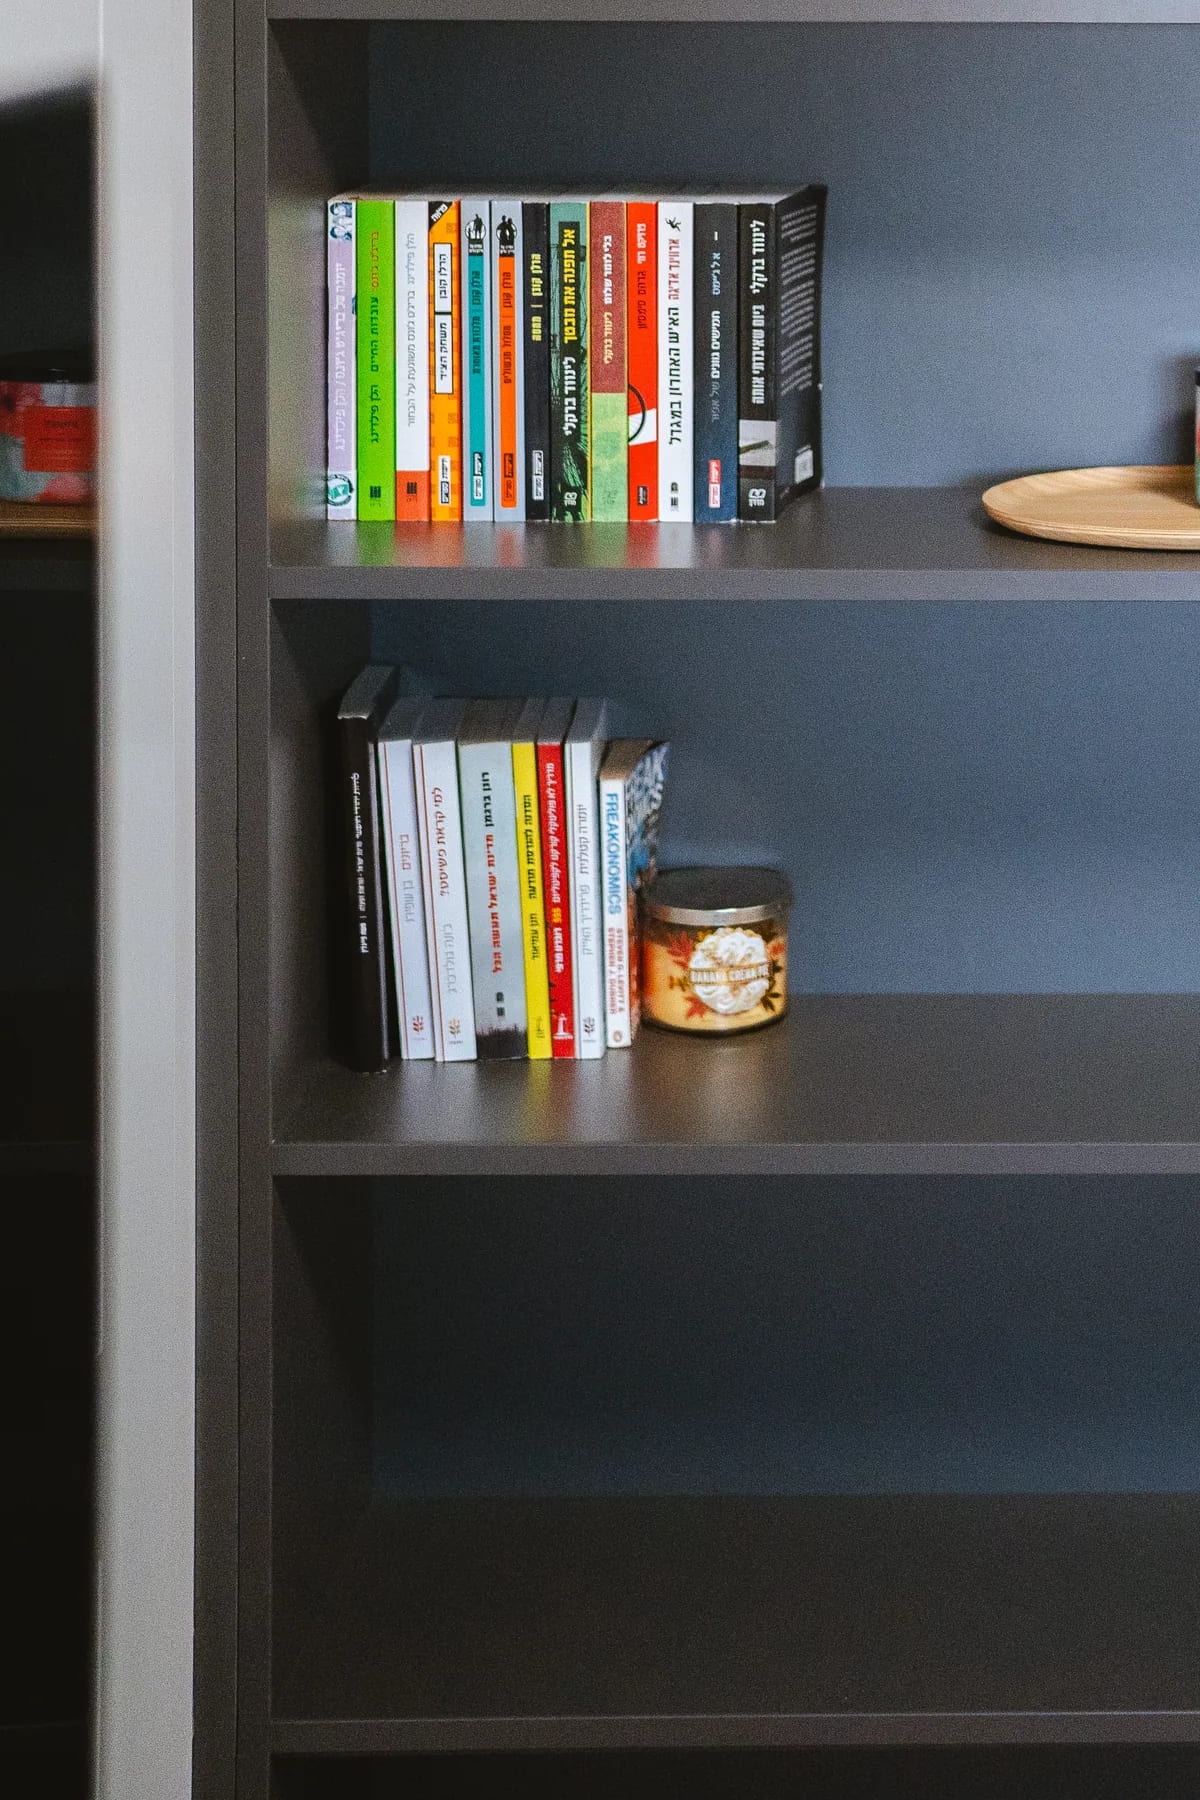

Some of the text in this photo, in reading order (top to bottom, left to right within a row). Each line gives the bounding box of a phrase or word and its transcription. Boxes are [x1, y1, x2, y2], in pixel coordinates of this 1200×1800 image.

[405, 233, 416, 249] הלן
[562, 228, 574, 246] אל
[437, 253, 448, 298] הרלן קובן
[563, 250, 574, 283] תפנה
[750, 258, 767, 293] ברקלי
[563, 286, 575, 303] את
[603, 280, 612, 304] שלום
[438, 322, 447, 354] משחק
[563, 307, 577, 343] מבטך
[710, 310, 720, 349] חמישים
[369, 340, 379, 371] החיים
[406, 344, 416, 380] משוגעת
[368, 384, 380, 401] הלן
[405, 382, 416, 395] על
[667, 347, 681, 444] האחרון במגדל
[751, 376, 763, 404] אותה
[370, 404, 380, 443] פילדינג
[407, 398, 415, 426] הבחור
[564, 397, 577, 435] ברקלי
[431, 786, 448, 844] למי קראת
[605, 793, 622, 914] FREAKONOMICS
[402, 879, 414, 888] בן
[480, 771, 502, 972] רונן ברגמן מדינת ישראל תעשה הכל
[526, 868, 536, 898] תודעה
